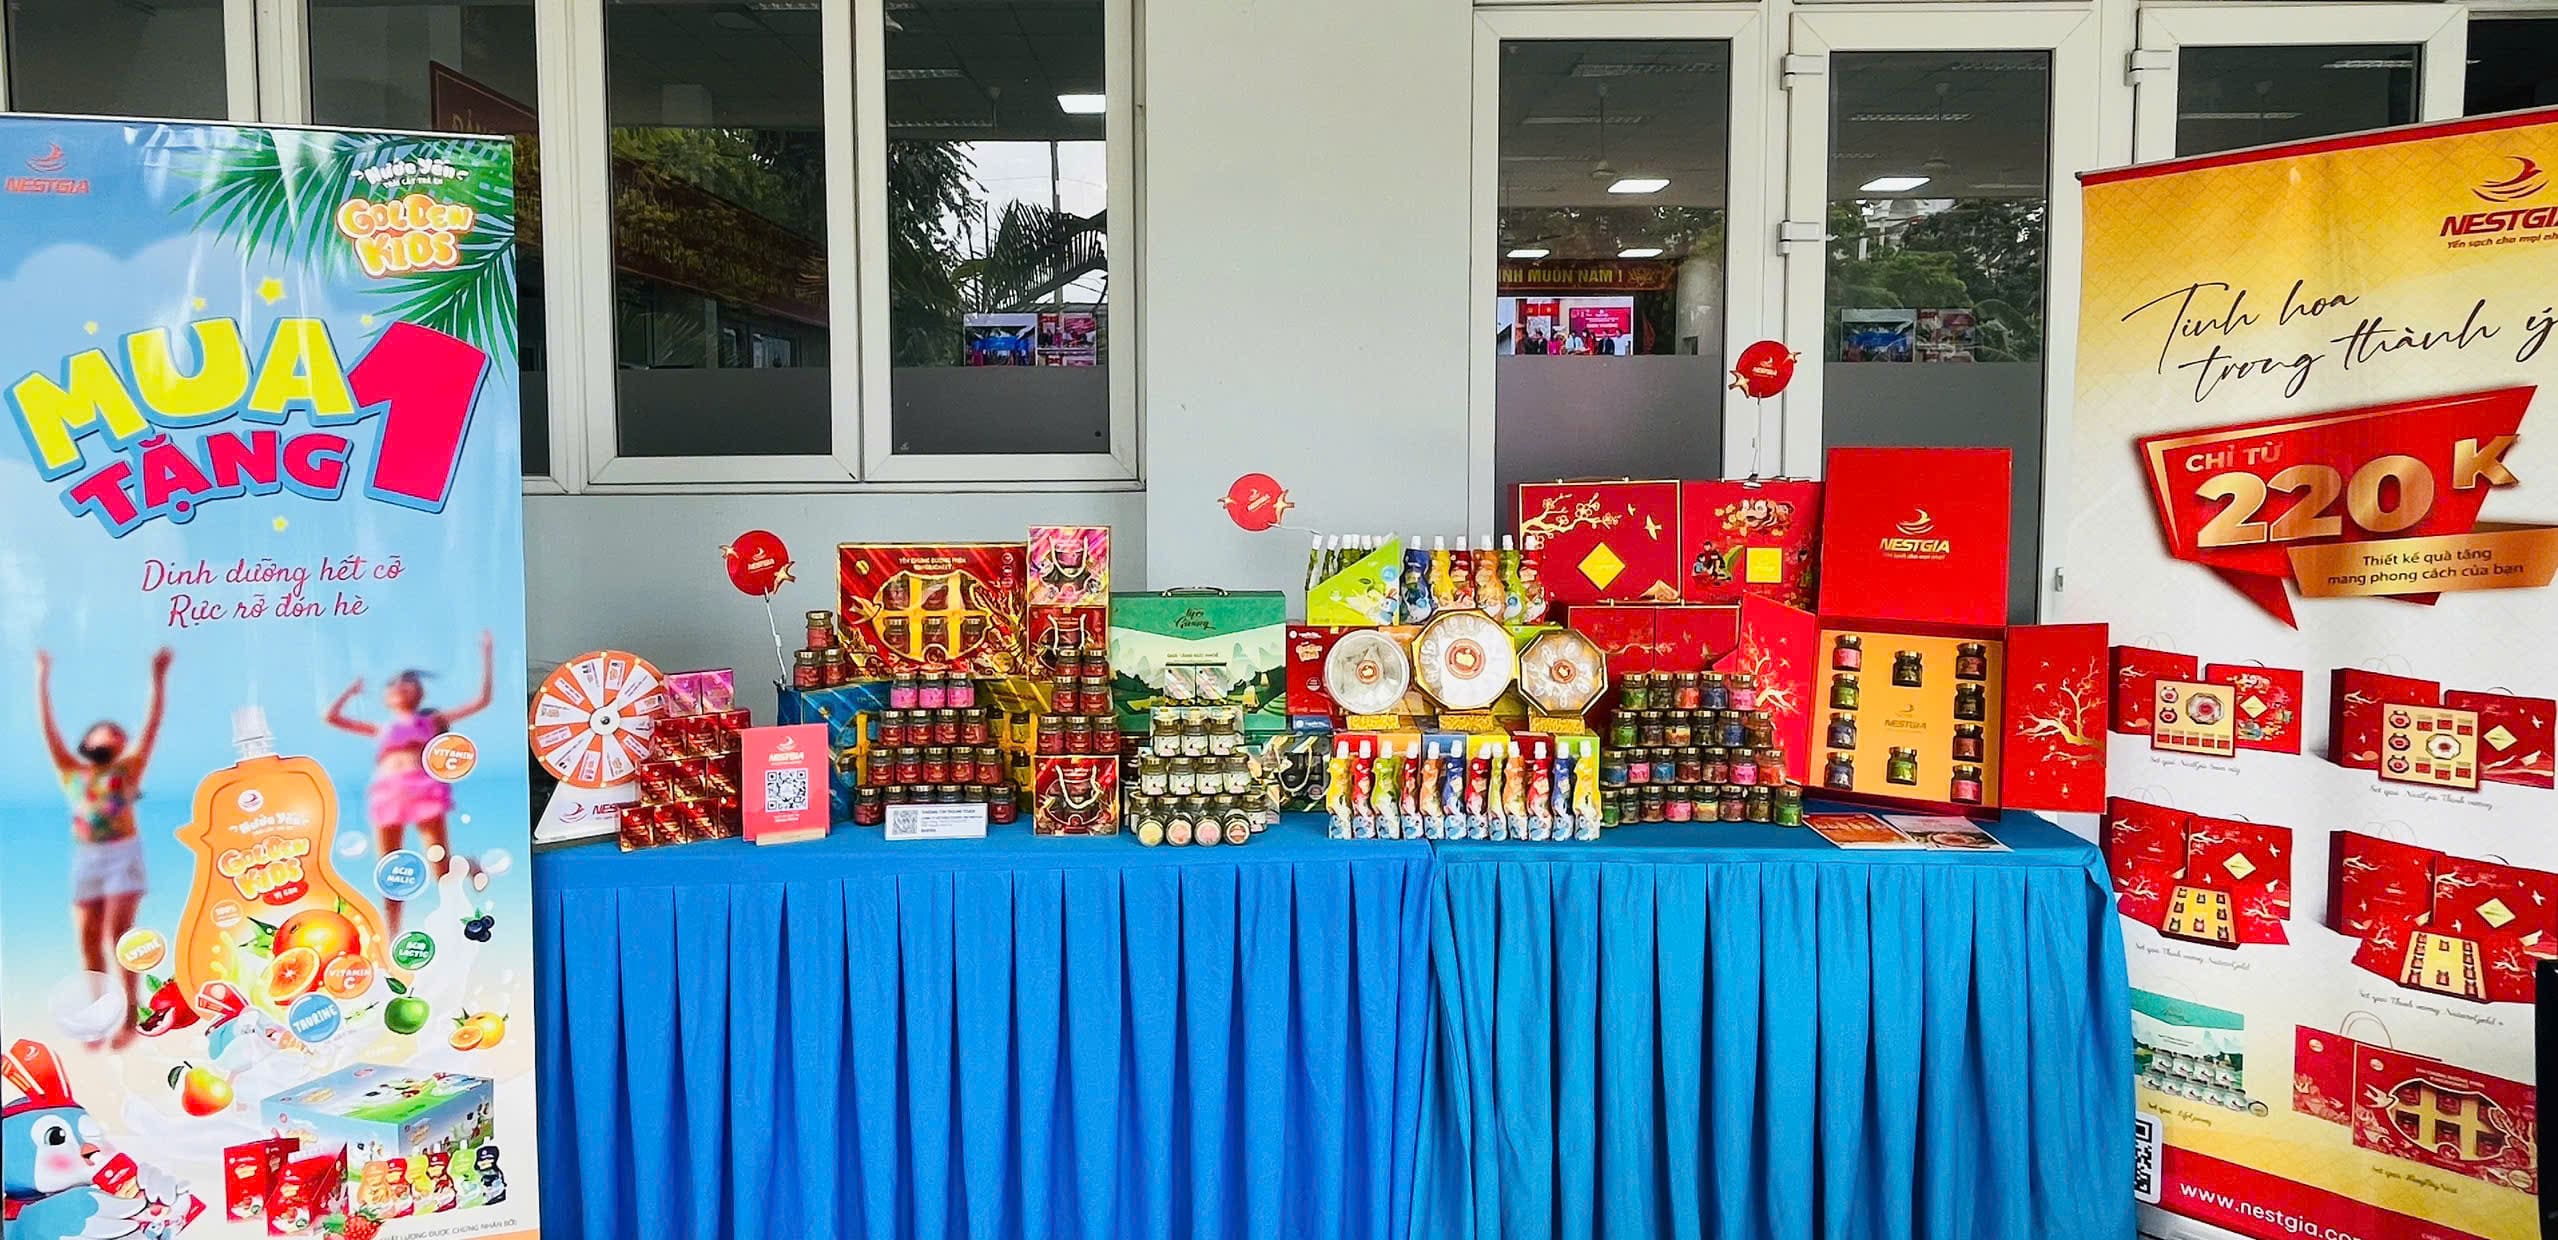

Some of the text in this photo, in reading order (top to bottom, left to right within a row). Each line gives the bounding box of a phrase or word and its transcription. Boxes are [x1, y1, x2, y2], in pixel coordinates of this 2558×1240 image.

[6, 178, 89, 194] NESTGIA
[2495, 237, 2516, 245] cho
[355, 230, 457, 277] KIDS
[2280, 280, 2360, 326] hoa
[2179, 345, 2325, 403] trong
[2331, 299, 2501, 370] thành
[12, 318, 354, 470] MUA
[69, 321, 486, 525] TẶNG 1
[2185, 441, 2284, 472] CHỈ TỪ
[2195, 434, 2521, 547] 220 K
[1880, 538, 1950, 553] NESTGIA
[2363, 552, 2398, 566] Thiết
[2402, 552, 2420, 564] kế
[2424, 550, 2453, 565] quà
[141, 554, 405, 597] Dinh dưỡng hết cỡ
[2328, 563, 2524, 586] mang phong cách của bạn
[168, 592, 368, 628] Rực rỡ đón hè
[434, 748, 474, 760] VITAMIN
[445, 758, 458, 770] C
[386, 875, 416, 884] MALIC
[392, 866, 415, 876] ACID
[398, 949, 429, 959] LACTIC
[329, 969, 370, 977] VITAMIN
[343, 977, 356, 990] C
[292, 1004, 338, 1032] TAURINE
